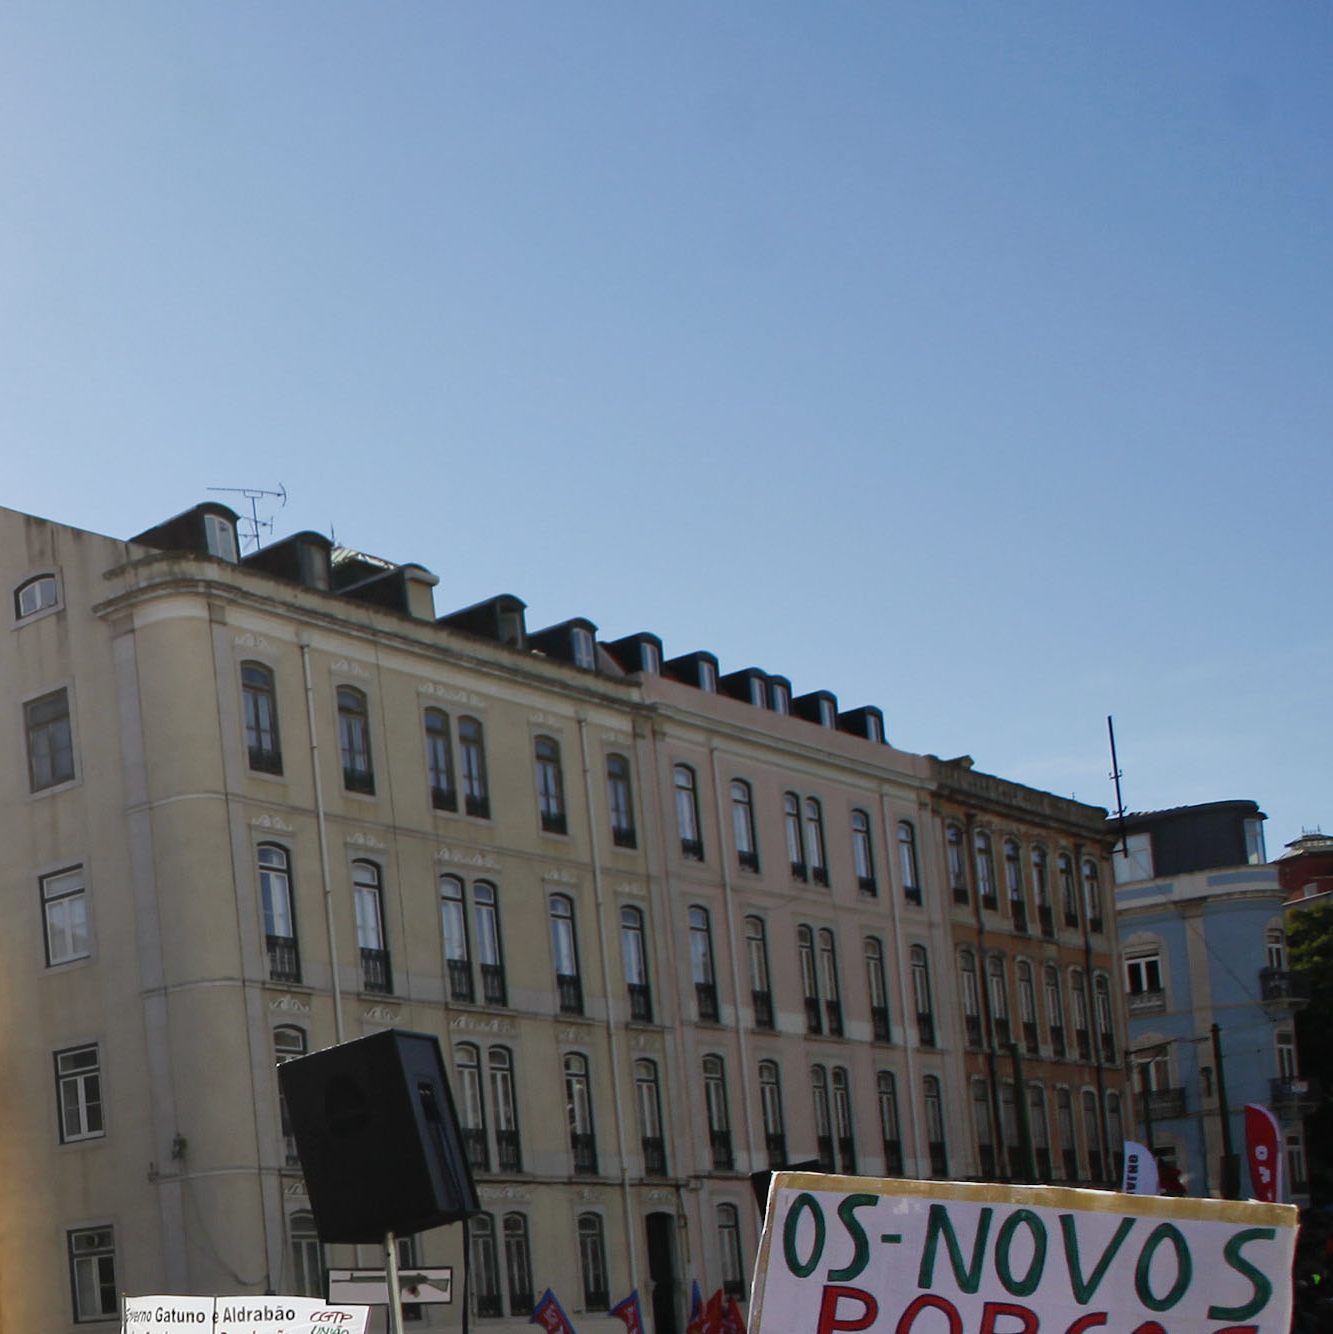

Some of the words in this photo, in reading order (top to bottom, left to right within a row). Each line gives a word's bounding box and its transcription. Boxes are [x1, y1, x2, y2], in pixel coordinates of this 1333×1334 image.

[155, 1306, 206, 1323] Gatuno
[212, 1311, 220, 1323] e
[222, 1305, 296, 1324] Aldrabão
[309, 1311, 354, 1324] CGTP
